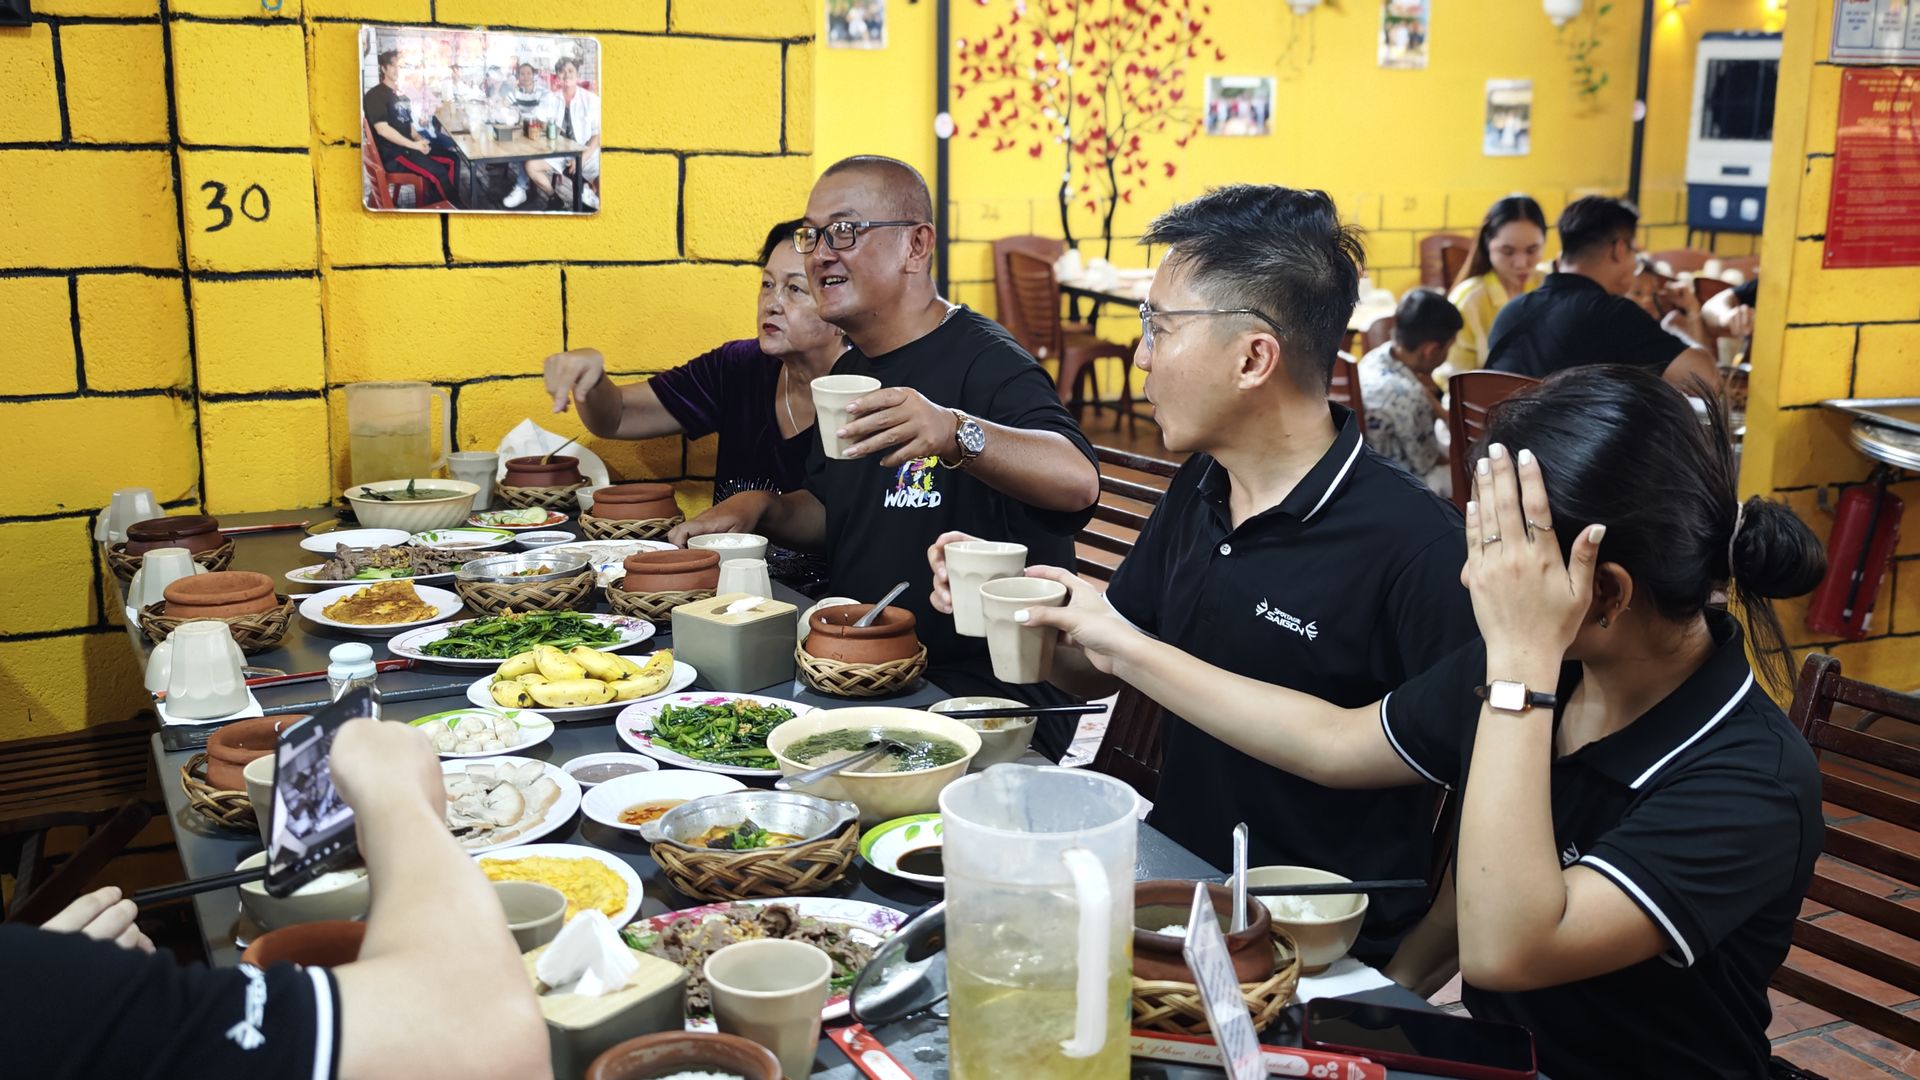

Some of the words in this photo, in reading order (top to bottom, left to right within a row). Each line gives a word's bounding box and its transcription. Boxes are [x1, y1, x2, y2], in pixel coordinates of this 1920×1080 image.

[201, 180, 270, 232] 30
[884, 486, 941, 508] WORLD
[1265, 610, 1304, 636] SAIGON
